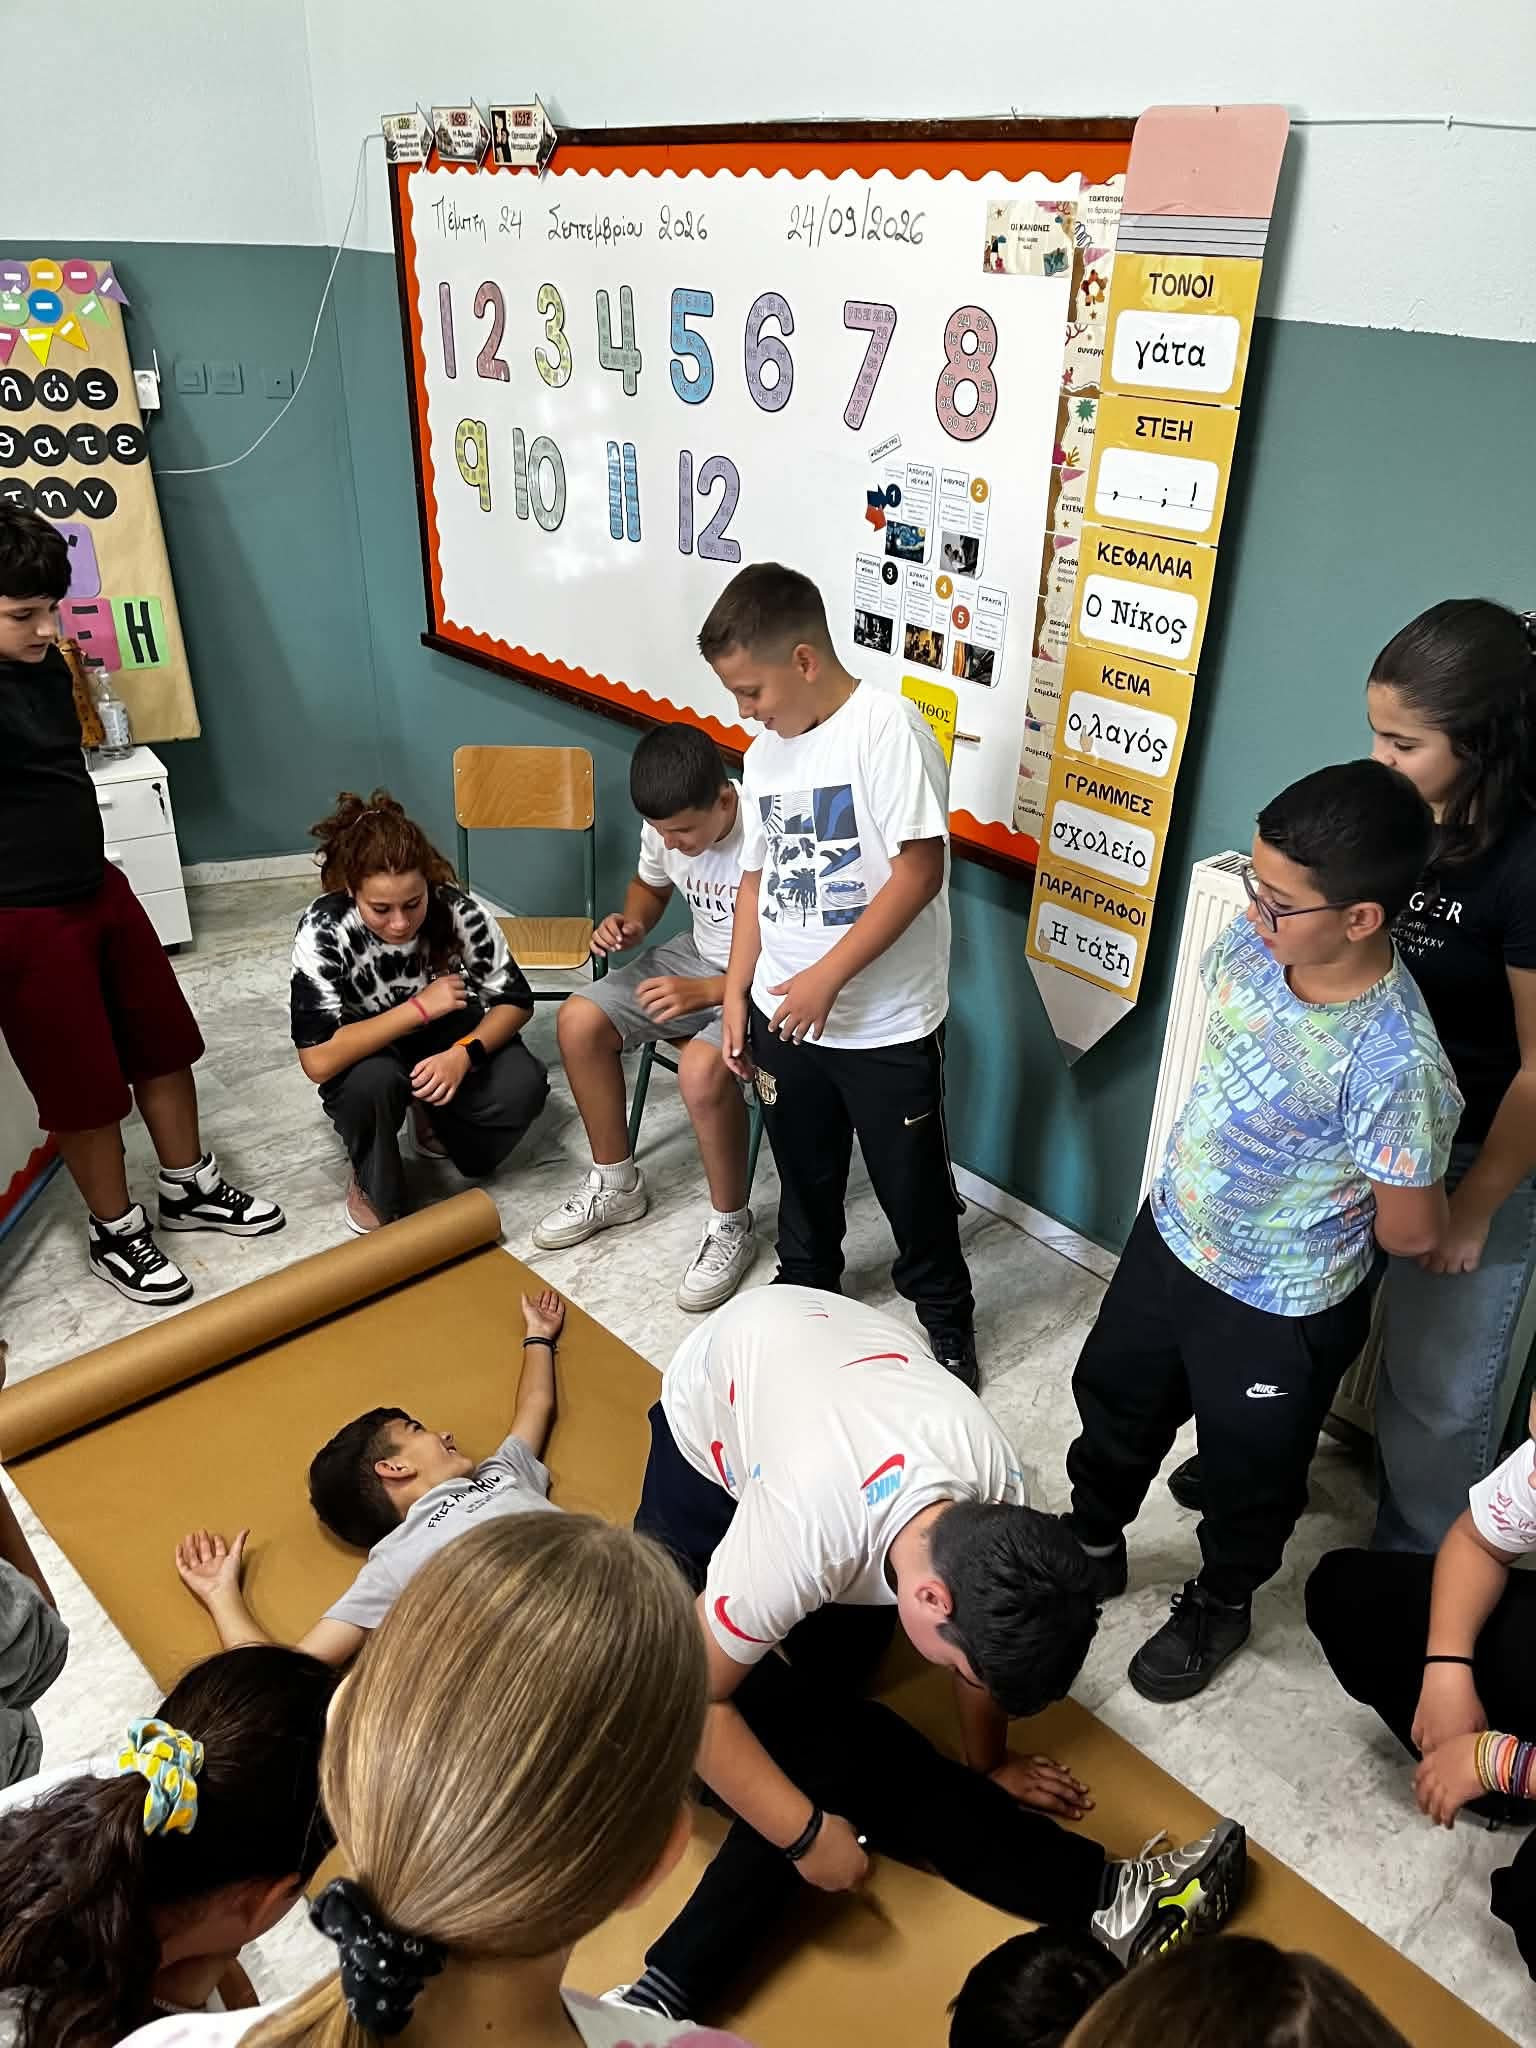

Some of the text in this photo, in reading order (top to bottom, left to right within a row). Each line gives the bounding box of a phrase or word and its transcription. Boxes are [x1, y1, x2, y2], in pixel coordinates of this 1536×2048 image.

[431, 195, 708, 249] Πέμπτη 24 Σεπτεμβρίου 2026
[787, 187, 927, 249] 24/09/2026
[1149, 272, 1214, 299] ΤΟΝΟΙ
[473, 280, 511, 383] 2
[534, 282, 573, 389] 3
[595, 284, 643, 397] 4
[669, 287, 714, 405] 5
[744, 291, 796, 413] 6
[1135, 333, 1206, 370] γάτα
[843, 300, 898, 431] 7
[935, 305, 999, 442] 8
[964, 418, 978, 433] 72
[1135, 415, 1194, 443] ΣΤΙΞΗ
[454, 418, 492, 512] 9
[512, 427, 567, 531] 10
[678, 449, 742, 563] 12
[890, 489, 897, 503] 1
[975, 483, 984, 500] 2
[885, 567, 894, 581] 3
[1097, 541, 1193, 580] ΚΕΦΑΛΑΙΑ
[940, 580, 948, 594] 4
[956, 609, 966, 625] 5
[1086, 593, 1188, 645] Ο Νίκος
[1101, 664, 1151, 697] ΚΕΝΑ
[910, 697, 952, 723] ΗΘΟΣ
[1068, 713, 1168, 764] ο λαγός
[1065, 772, 1154, 817] ΓΡΑΜΜΕΣ
[1053, 821, 1147, 868] σχολείο
[1039, 871, 1146, 927] ΠΑΡΑΓΡΑΦΟΙ
[1050, 920, 1130, 977] Η τάξη
[1253, 1383, 1279, 1394] NIKE
